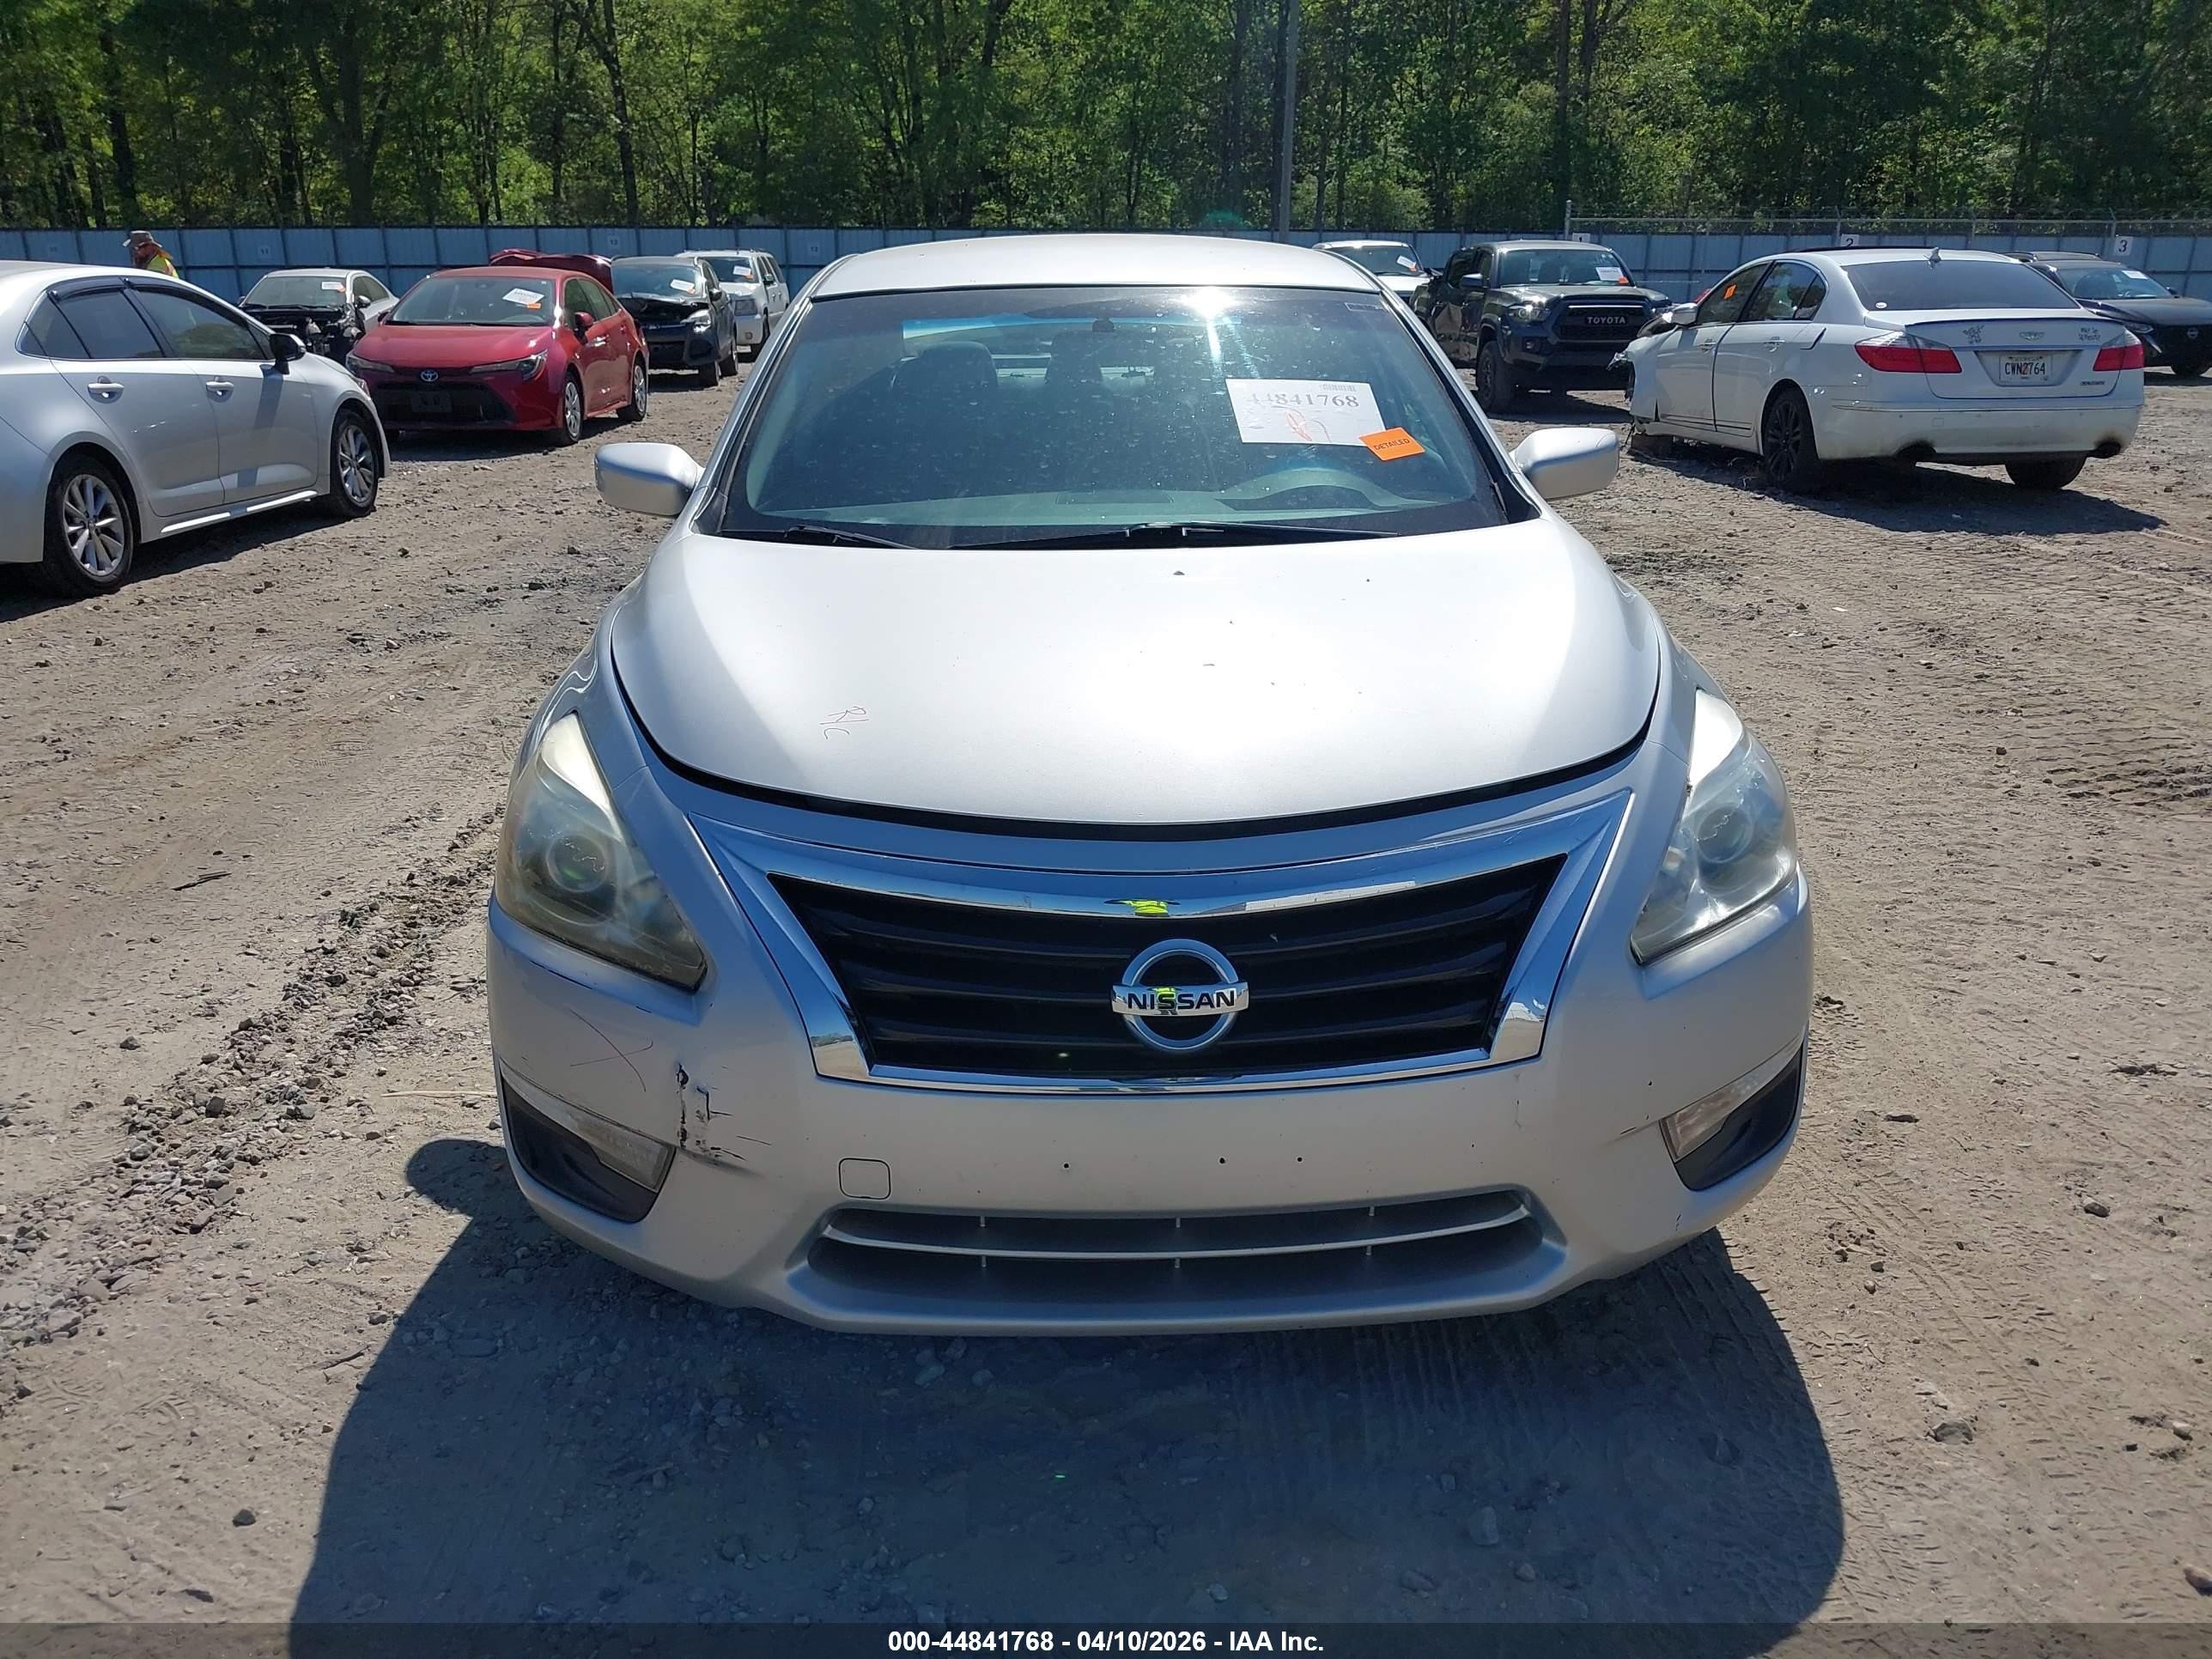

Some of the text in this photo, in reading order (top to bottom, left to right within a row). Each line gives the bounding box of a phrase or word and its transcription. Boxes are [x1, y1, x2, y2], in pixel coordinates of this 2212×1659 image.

[1845, 238, 1854, 247] 2
[2118, 240, 2128, 252] 3
[1587, 316, 1626, 325] TOYOTA
[2004, 362, 2046, 375] CWN2764
[1248, 392, 1359, 408] 44841768
[1373, 437, 1411, 452] DETAILED
[1127, 989, 1235, 1010] NISSAN
